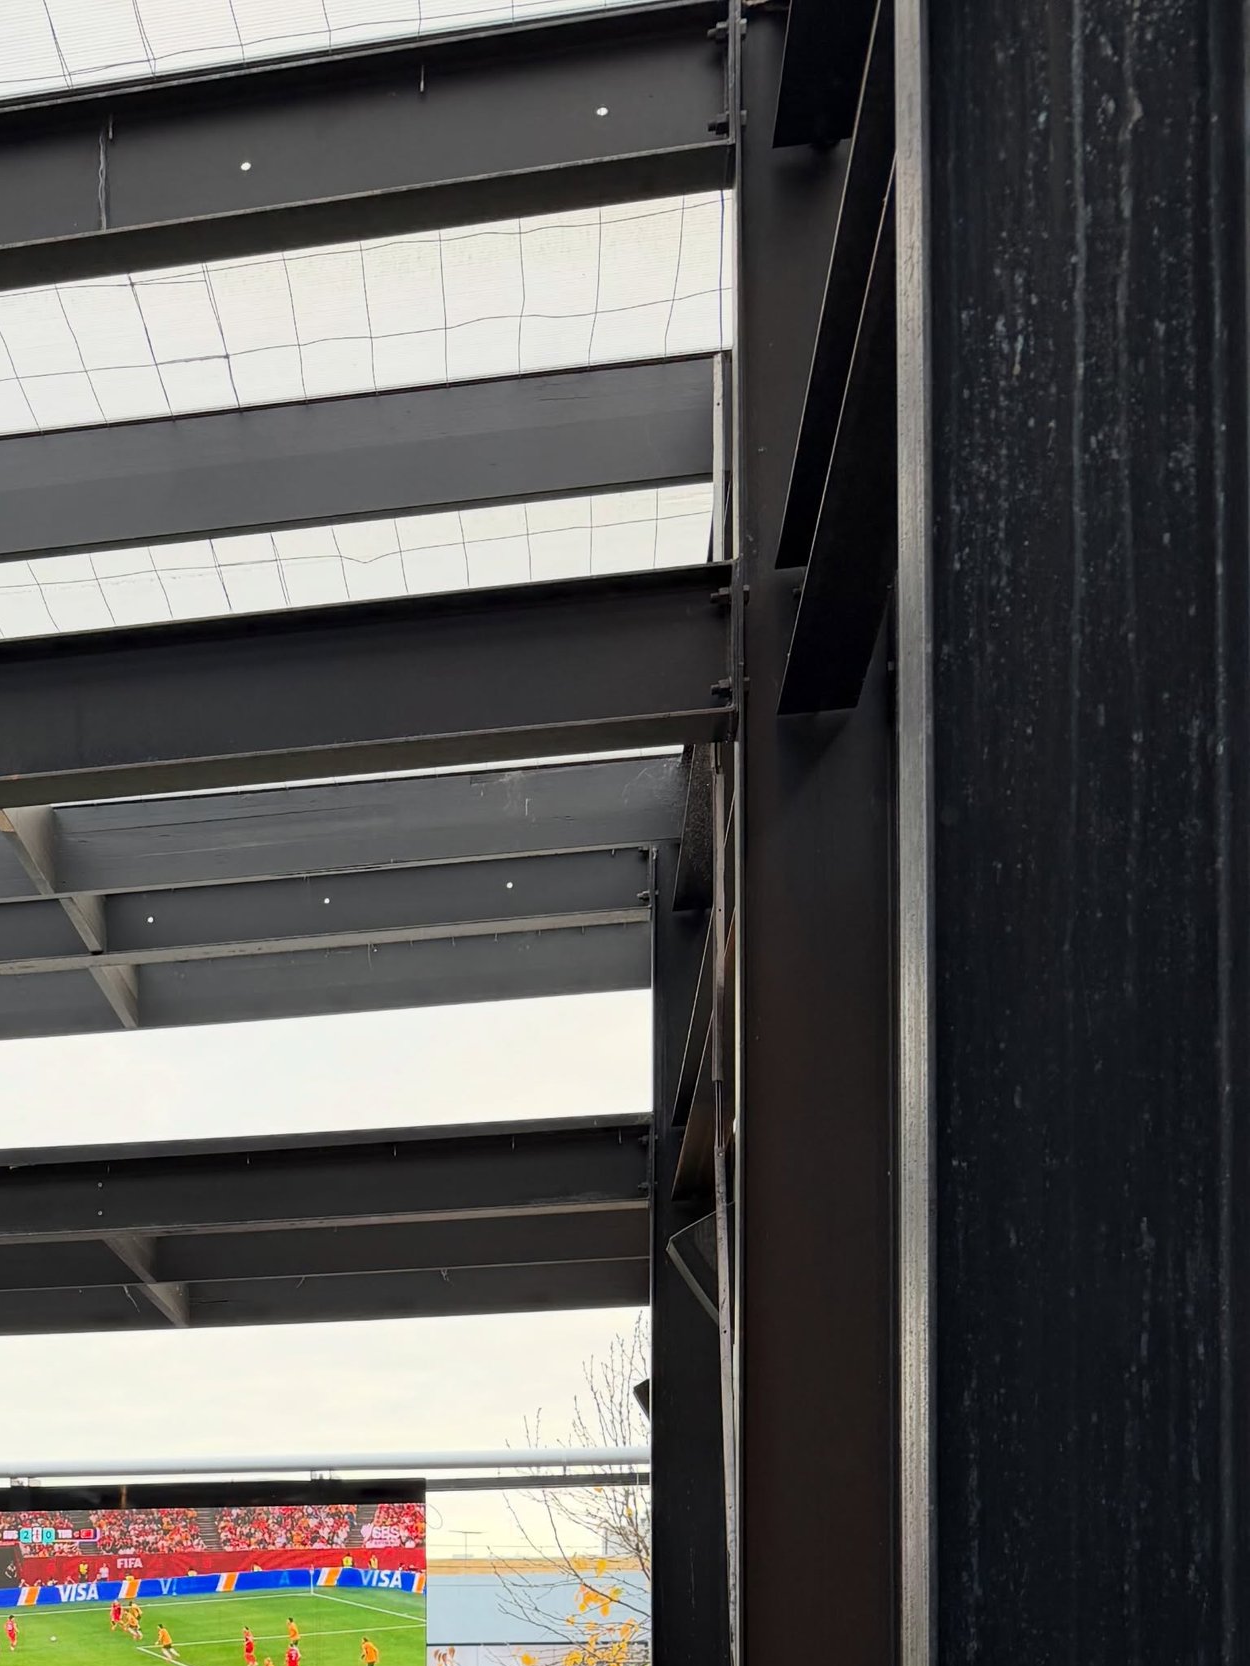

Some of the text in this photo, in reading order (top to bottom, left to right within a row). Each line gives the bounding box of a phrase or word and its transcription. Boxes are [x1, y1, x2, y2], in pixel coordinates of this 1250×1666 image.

[116, 1557, 143, 1569] FIFA
[360, 1569, 403, 1588] VISA
[56, 1582, 99, 1602] VISA
